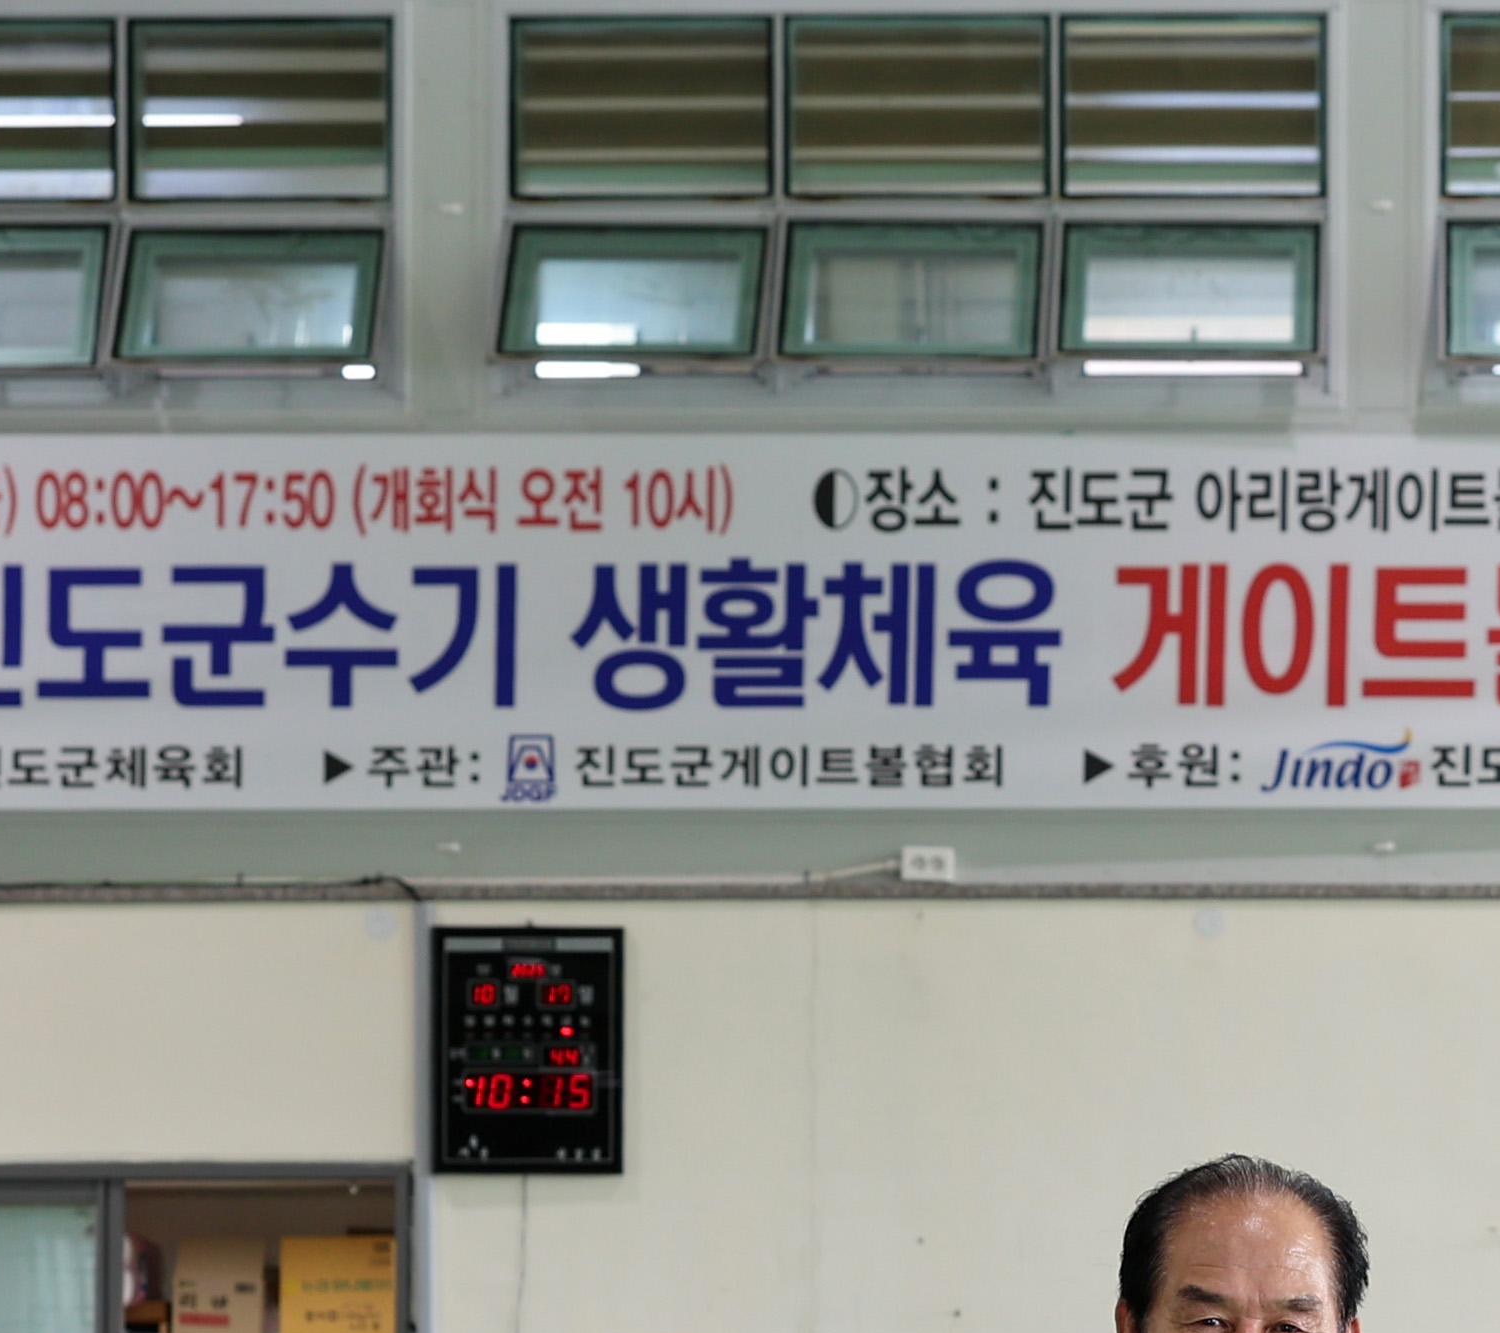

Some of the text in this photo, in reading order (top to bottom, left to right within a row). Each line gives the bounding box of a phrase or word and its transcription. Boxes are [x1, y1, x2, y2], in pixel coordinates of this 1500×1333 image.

[36, 471, 335, 529] 08:00~17:50
[354, 467, 496, 533] (개회식
[518, 468, 601, 532] 오전
[626, 468, 733, 533] 10시)
[866, 468, 960, 533] 장소
[1030, 468, 1172, 530] 진도군
[571, 558, 1061, 711] 생활체육
[369, 745, 1002, 788] 주관: 진도군게이트볼협회
[1129, 745, 1240, 786] 후원:
[549, 1046, 580, 1066] 44
[472, 1073, 590, 1110] 10:15
